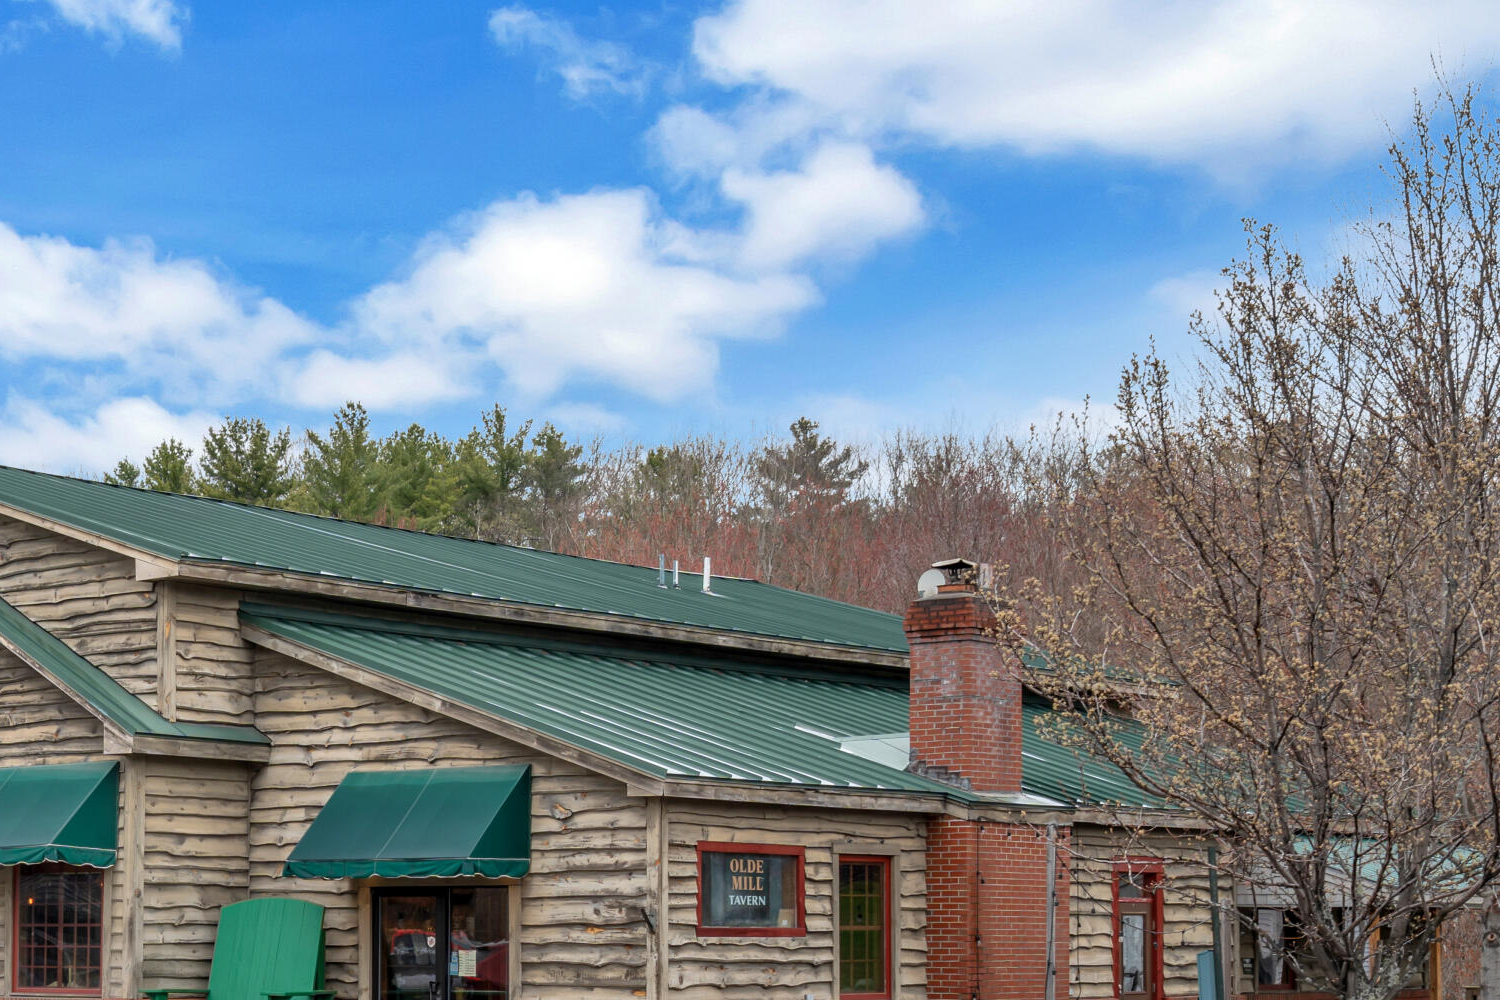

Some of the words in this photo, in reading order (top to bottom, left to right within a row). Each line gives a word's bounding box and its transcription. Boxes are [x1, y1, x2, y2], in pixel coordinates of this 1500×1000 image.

[729, 858, 764, 874] OLDE
[732, 876, 764, 891] MILL
[728, 895, 766, 906] TAVERN
